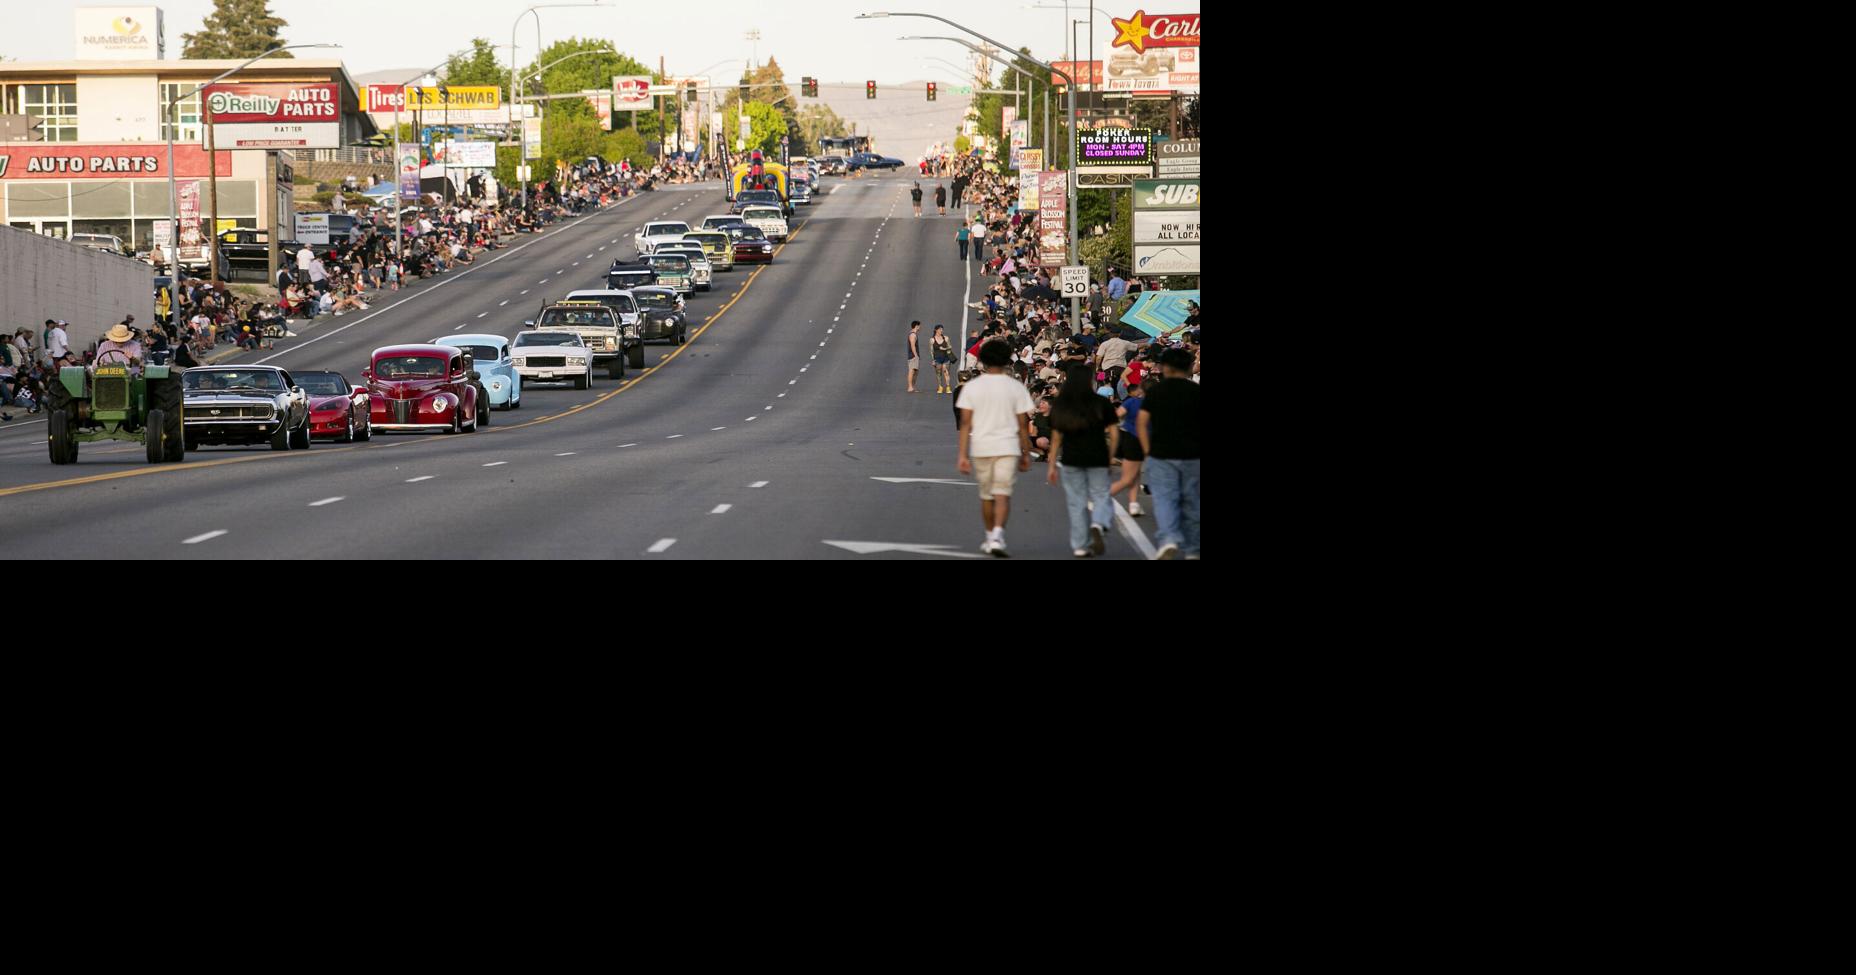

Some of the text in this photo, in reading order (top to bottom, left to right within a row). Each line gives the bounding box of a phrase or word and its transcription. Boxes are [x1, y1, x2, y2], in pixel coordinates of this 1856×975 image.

[83, 35, 148, 44] NUMERICA
[288, 88, 330, 101] AUTO
[369, 86, 404, 110] Tires
[438, 91, 495, 105] SCHWAB
[209, 91, 281, 115] O'Reilly
[283, 103, 335, 116] PARTS
[1163, 143, 1200, 154] COLU
[27, 156, 85, 172] AUTO
[89, 156, 158, 172] PARTS
[1145, 184, 1200, 205] SUB
[1065, 283, 1086, 294] 30
